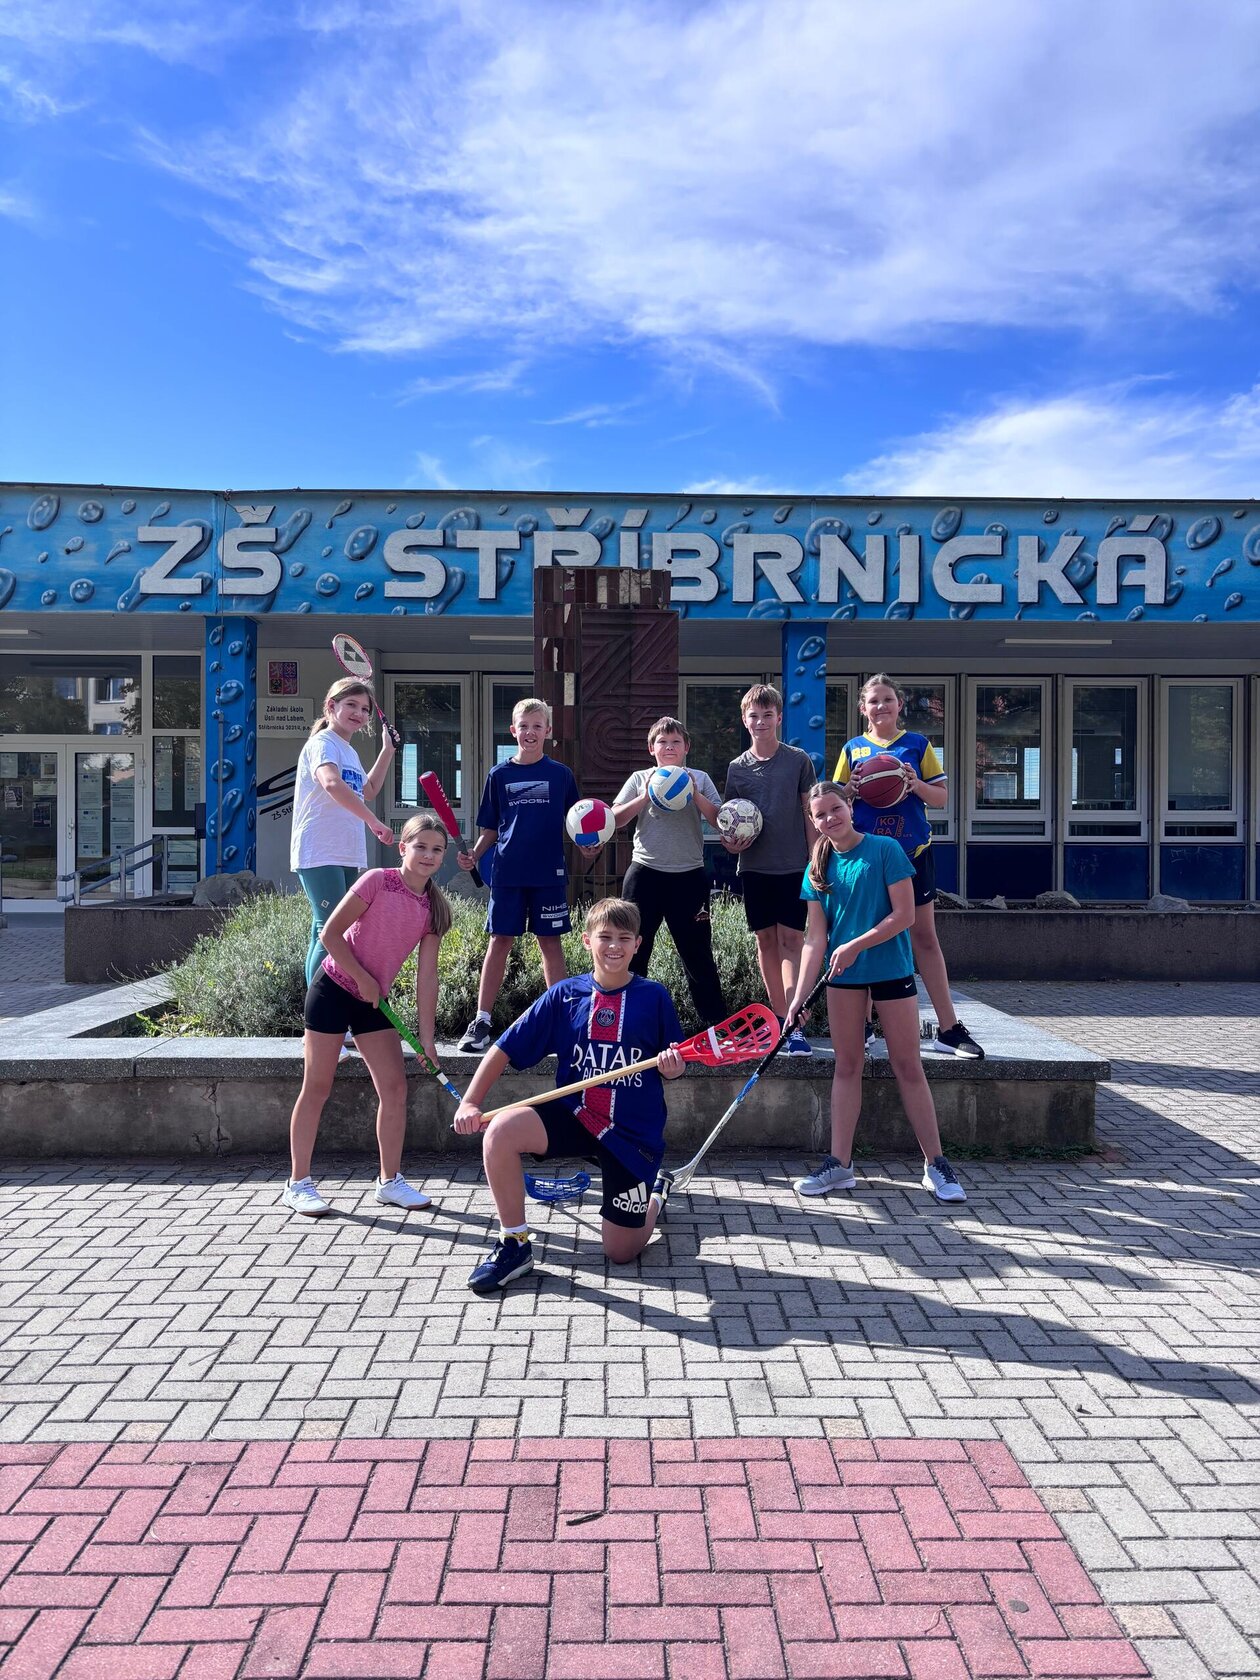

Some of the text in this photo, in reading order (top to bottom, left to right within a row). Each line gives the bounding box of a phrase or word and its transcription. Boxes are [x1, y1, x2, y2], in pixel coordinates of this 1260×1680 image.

[138, 505, 1167, 605] ZŠ STŘÍBRNICKÁ
[266, 704, 304, 713] Základní škola
[264, 713, 275, 721] Ústí
[276, 714, 286, 722] nad
[508, 798, 550, 807] SWOOSH
[271, 810, 282, 821] ZŠ
[880, 817, 896, 826] KO
[876, 827, 892, 835] RA
[570, 1042, 643, 1072] QATAR
[612, 1197, 649, 1214] adidas
